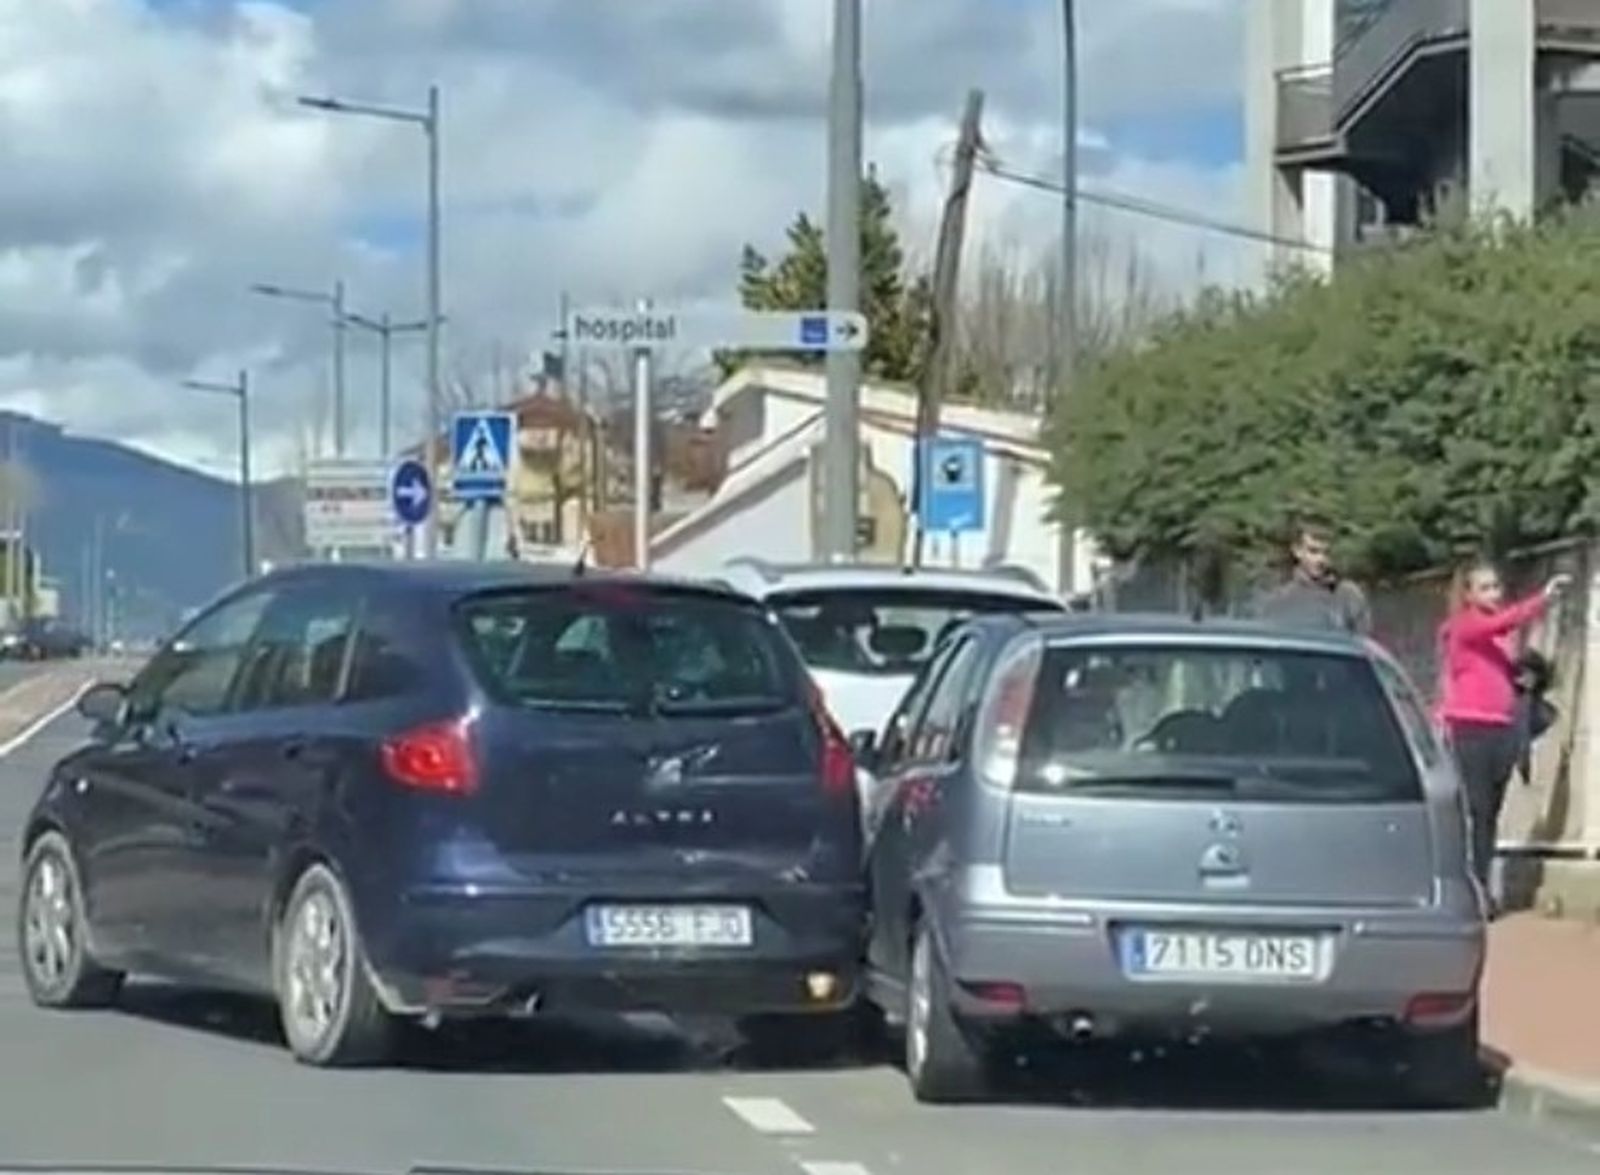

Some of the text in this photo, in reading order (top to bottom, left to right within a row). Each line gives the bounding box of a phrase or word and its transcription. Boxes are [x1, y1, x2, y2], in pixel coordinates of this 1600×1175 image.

[575, 315, 675, 342] hospital
[1152, 935, 1308, 970] 7115 DNS
